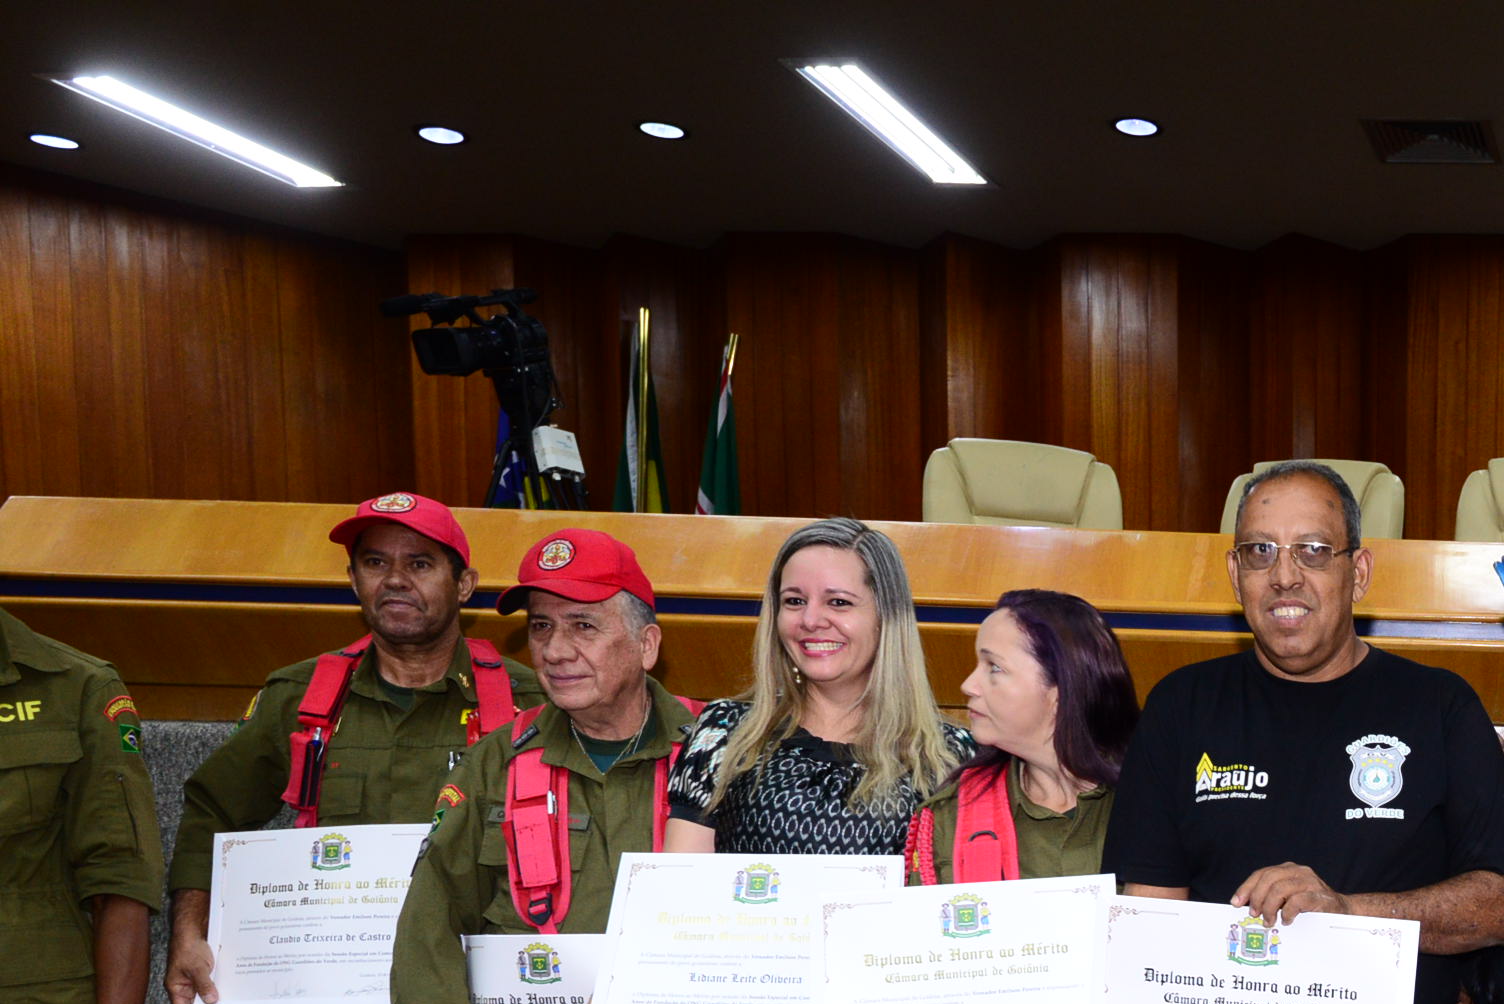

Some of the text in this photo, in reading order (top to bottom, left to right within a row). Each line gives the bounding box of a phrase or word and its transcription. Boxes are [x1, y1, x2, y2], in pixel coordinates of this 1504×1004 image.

[1346, 808, 1404, 819] DO VERDE
[250, 882, 293, 896] Diploma
[298, 881, 309, 891] de
[314, 879, 351, 890] Honra
[264, 895, 398, 908] Câmara Municipal de Goiânia
[269, 933, 391, 945] Claudio Teixeira de Castro
[864, 943, 1068, 968] Diploma de Honra ao Mérito
[689, 972, 802, 984] Lidiane Leite Oliveira
[885, 964, 1049, 984] Câmara Municipal de Goiânia
[1143, 967, 1357, 1001] Diploma de Honra ao Mérito
[526, 992, 566, 1004] Honra
[567, 995, 584, 1004] ao
